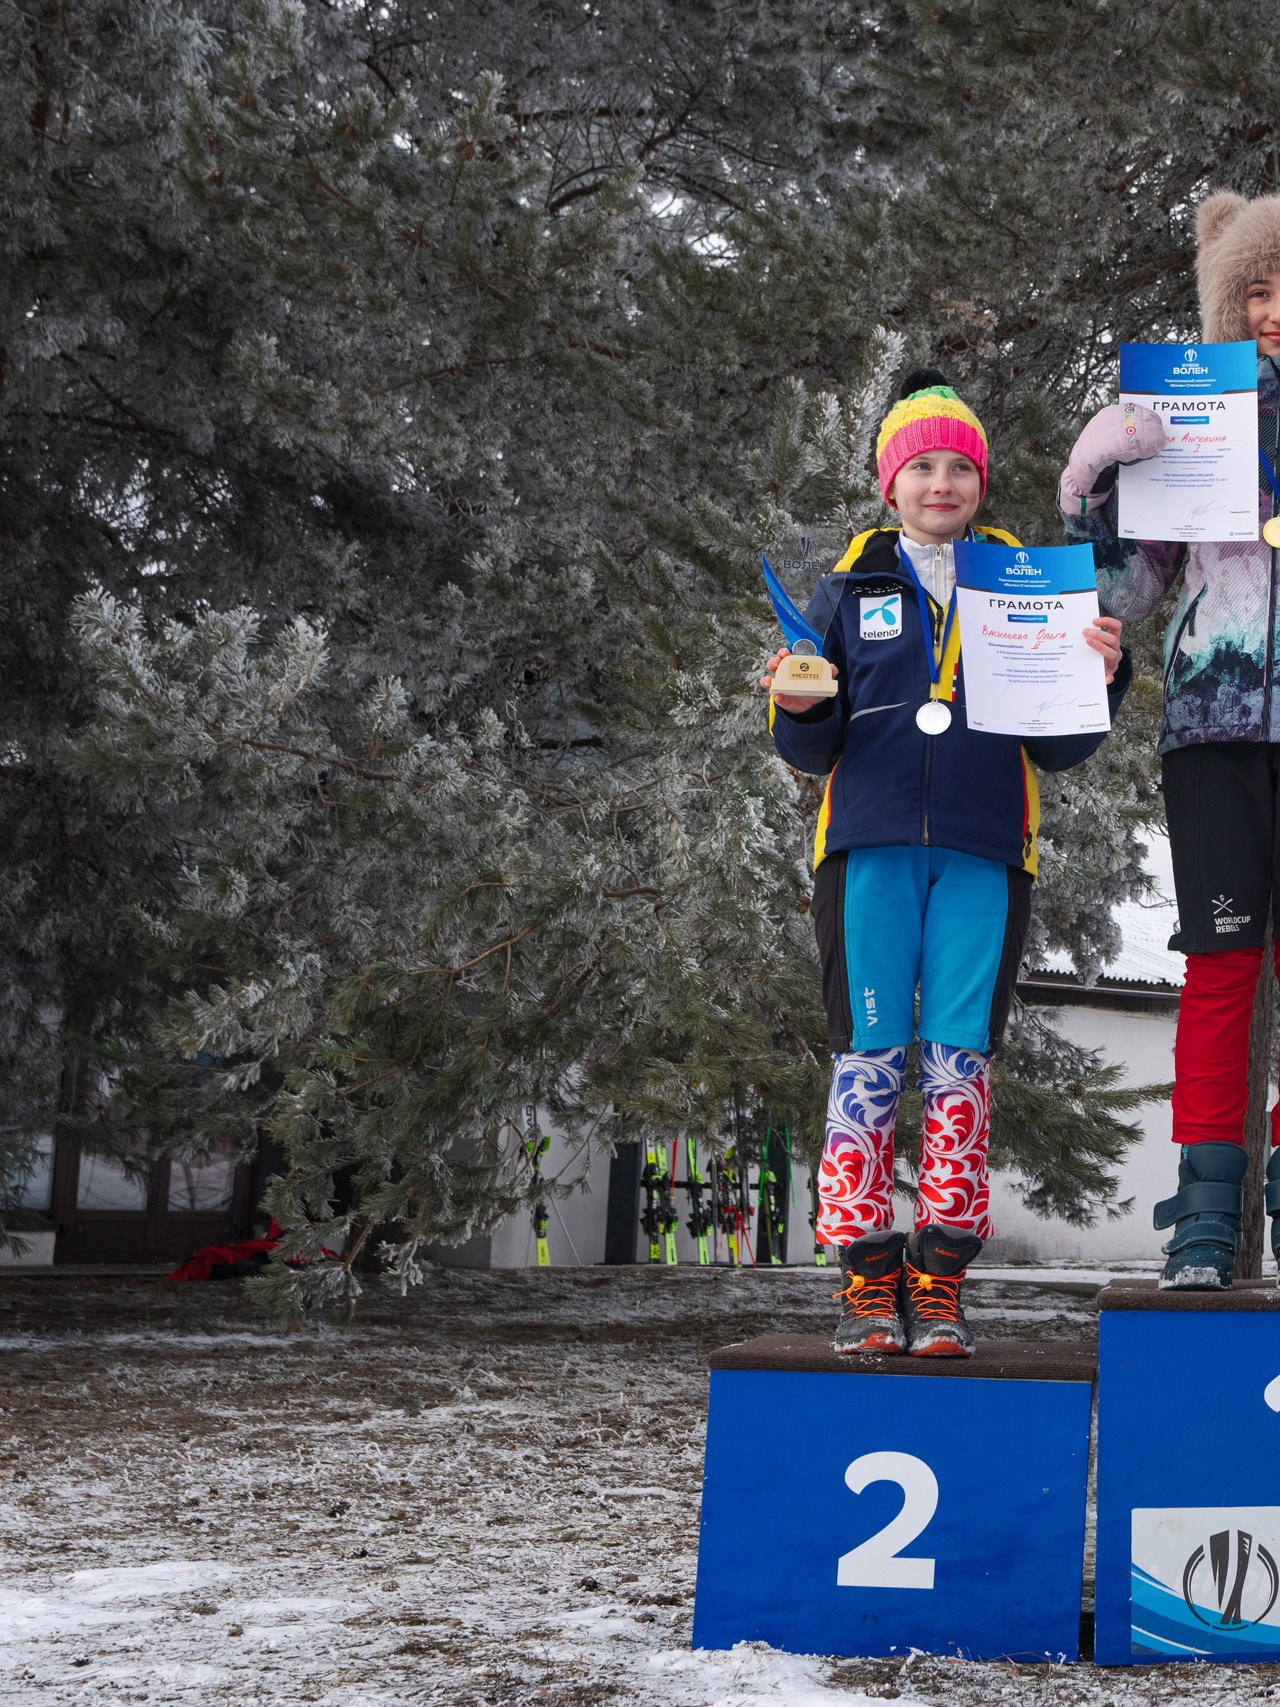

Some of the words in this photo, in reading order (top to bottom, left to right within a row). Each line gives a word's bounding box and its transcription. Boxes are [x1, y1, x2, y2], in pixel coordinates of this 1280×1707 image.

[1173, 367, 1208, 375] ВОЛЕН
[1153, 401, 1226, 411] ГРАМОТА
[1181, 432, 1227, 443] Ангелина
[784, 560, 828, 570] ВОЛЕН
[1005, 567, 1042, 576] ВОЛЕН
[989, 598, 1065, 610] ГРАМОТА
[863, 629, 900, 638] telenor
[982, 624, 1028, 640] Васильева
[1036, 628, 1067, 640] Ольга
[800, 663, 809, 671] 2
[1214, 916, 1251, 926] WORLDCUP
[1216, 924, 1240, 934] REBELS
[836, 1451, 939, 1589] 2
